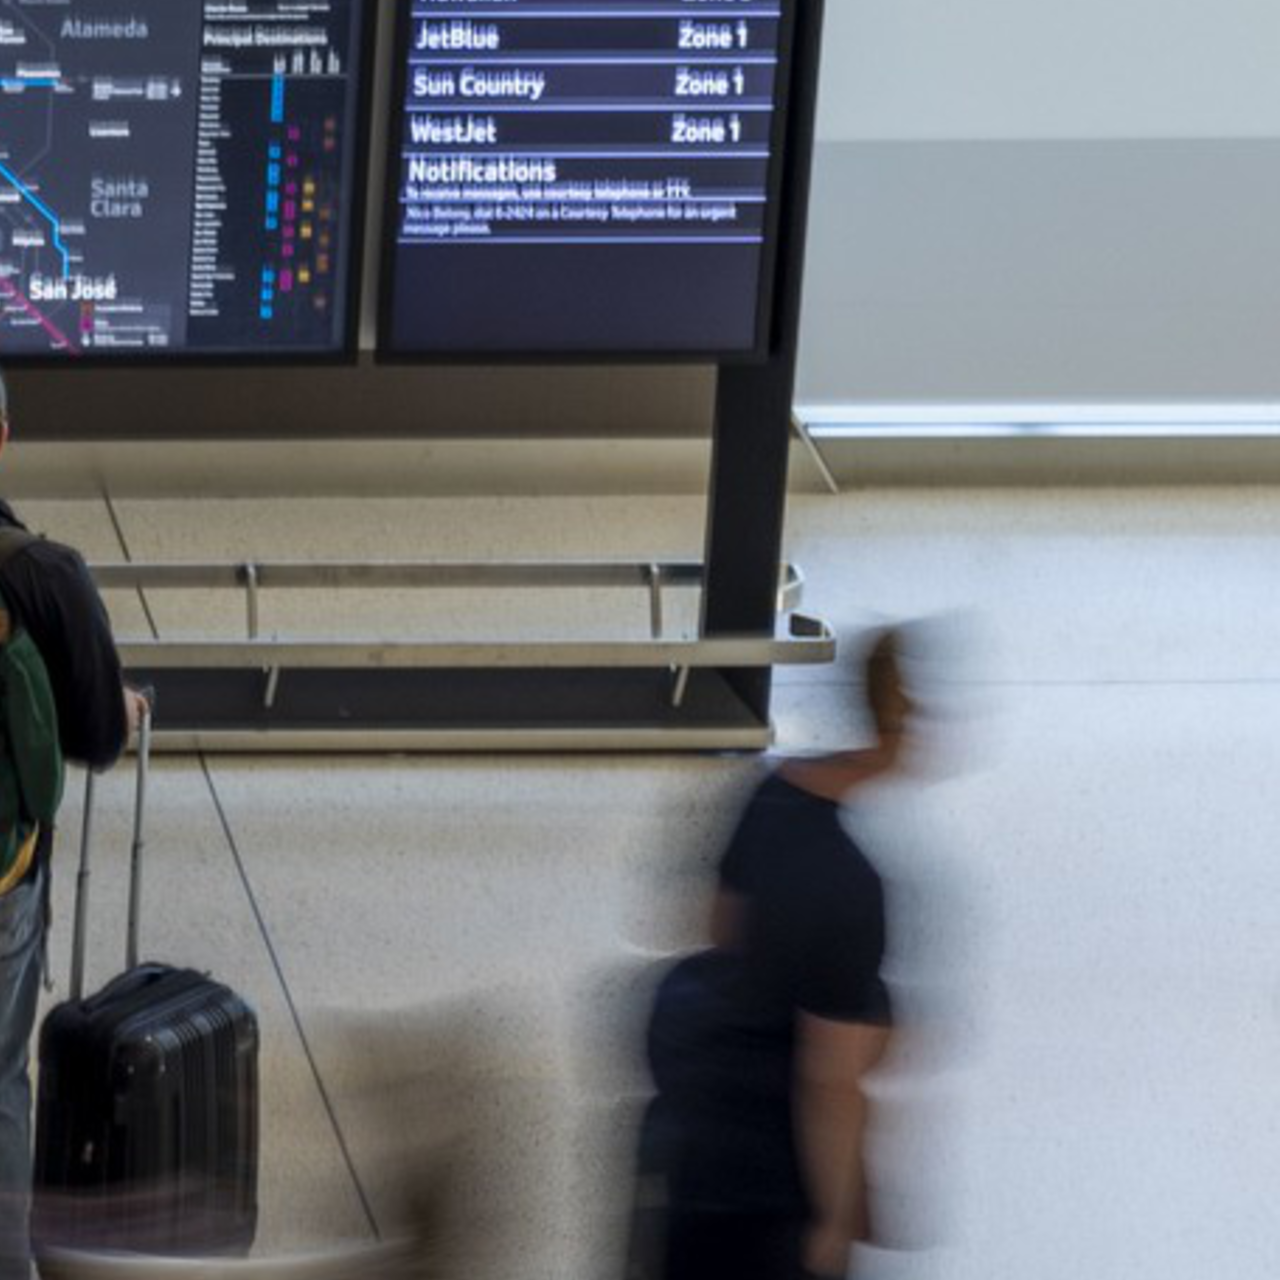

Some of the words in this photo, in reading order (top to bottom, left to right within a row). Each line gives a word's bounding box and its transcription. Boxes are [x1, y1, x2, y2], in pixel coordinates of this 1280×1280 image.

[61, 17, 148, 39] Alameda
[416, 21, 499, 49] JetBlue
[678, 21, 731, 48] Zone
[736, 21, 747, 48] 1
[414, 68, 455, 95] Sun
[459, 68, 545, 100] Country
[675, 68, 729, 95] Zone
[733, 68, 744, 95] 1
[411, 116, 496, 143] WestJet
[672, 115, 725, 142] Zone
[729, 115, 741, 142] 1
[409, 155, 556, 182] Notifications
[91, 178, 148, 198] Santa
[91, 198, 142, 217] Clara
[29, 277, 68, 300] San
[71, 276, 116, 300] José
